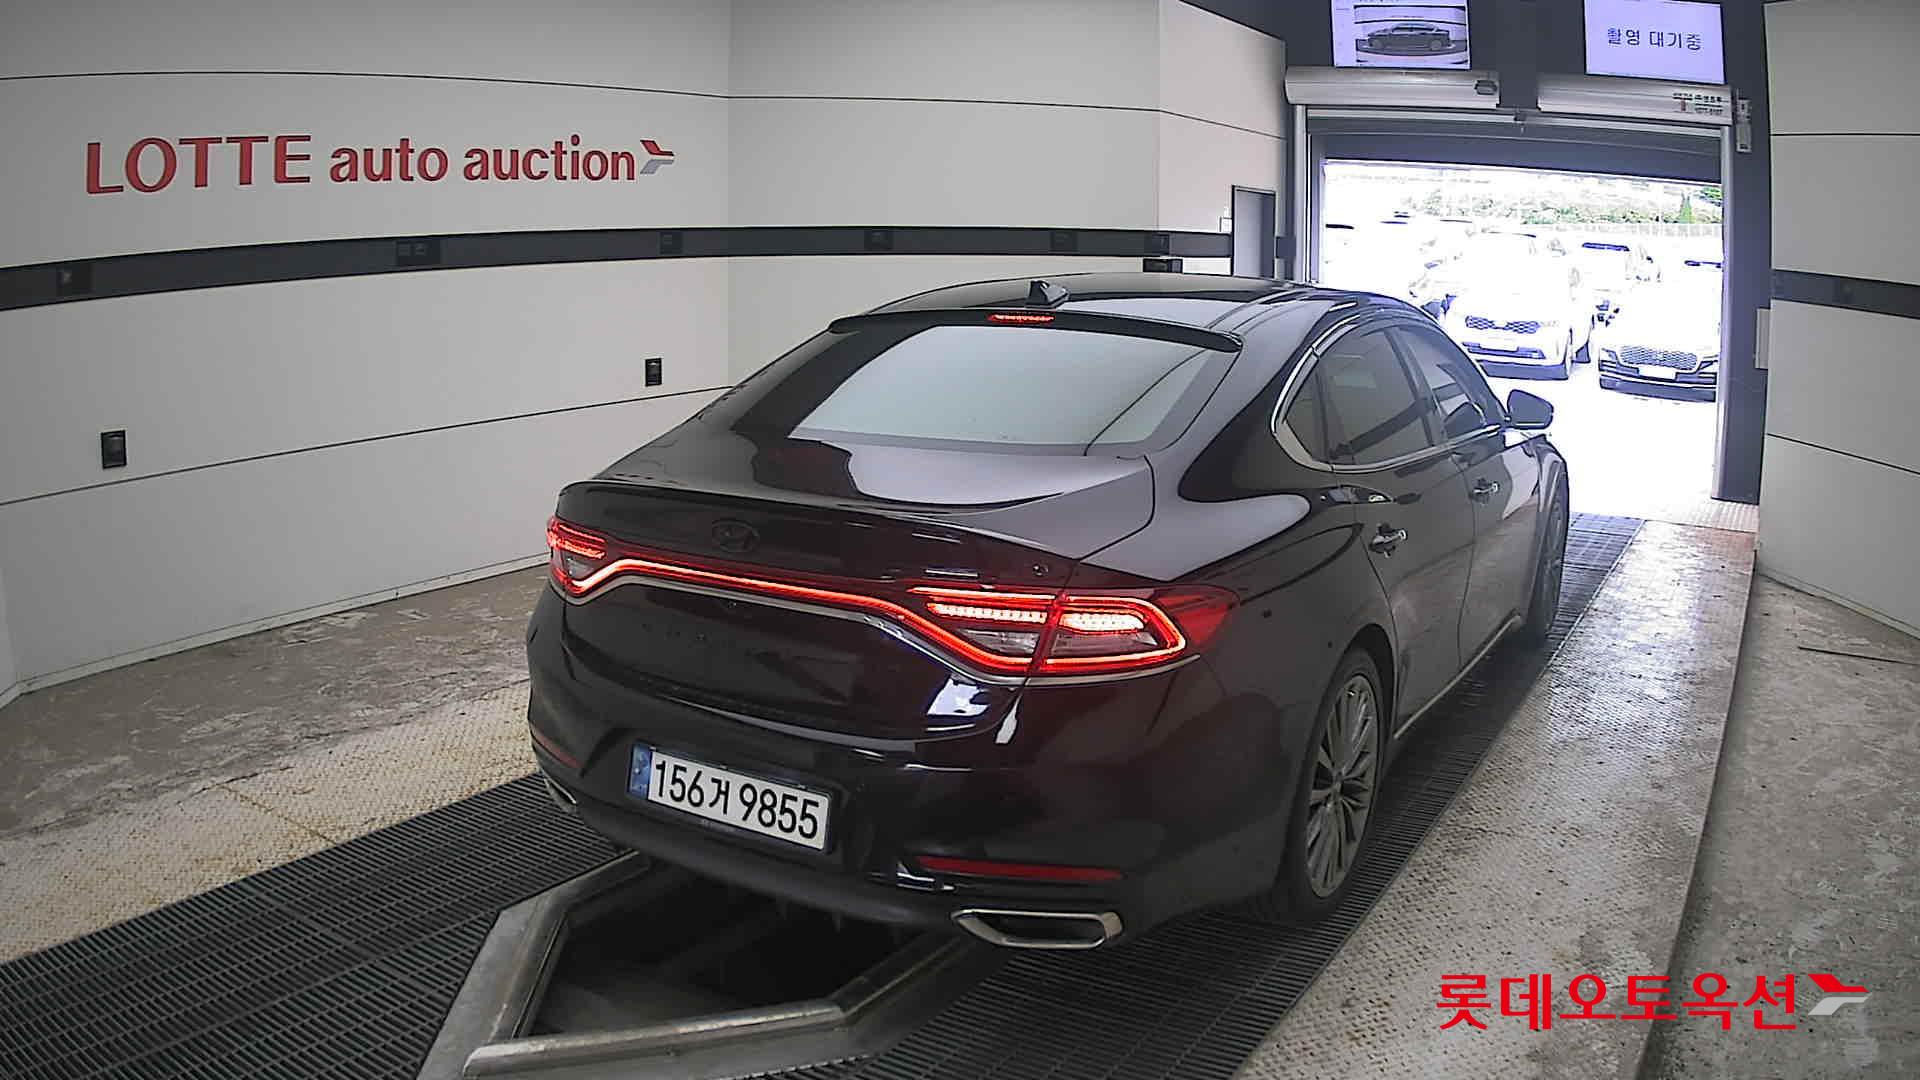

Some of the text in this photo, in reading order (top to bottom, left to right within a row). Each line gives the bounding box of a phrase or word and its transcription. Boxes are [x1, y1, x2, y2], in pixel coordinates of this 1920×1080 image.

[1607, 28, 1701, 51] 촬영 대기중
[86, 133, 636, 194] LOTTE auto auction
[655, 760, 820, 839] 156거 9855
